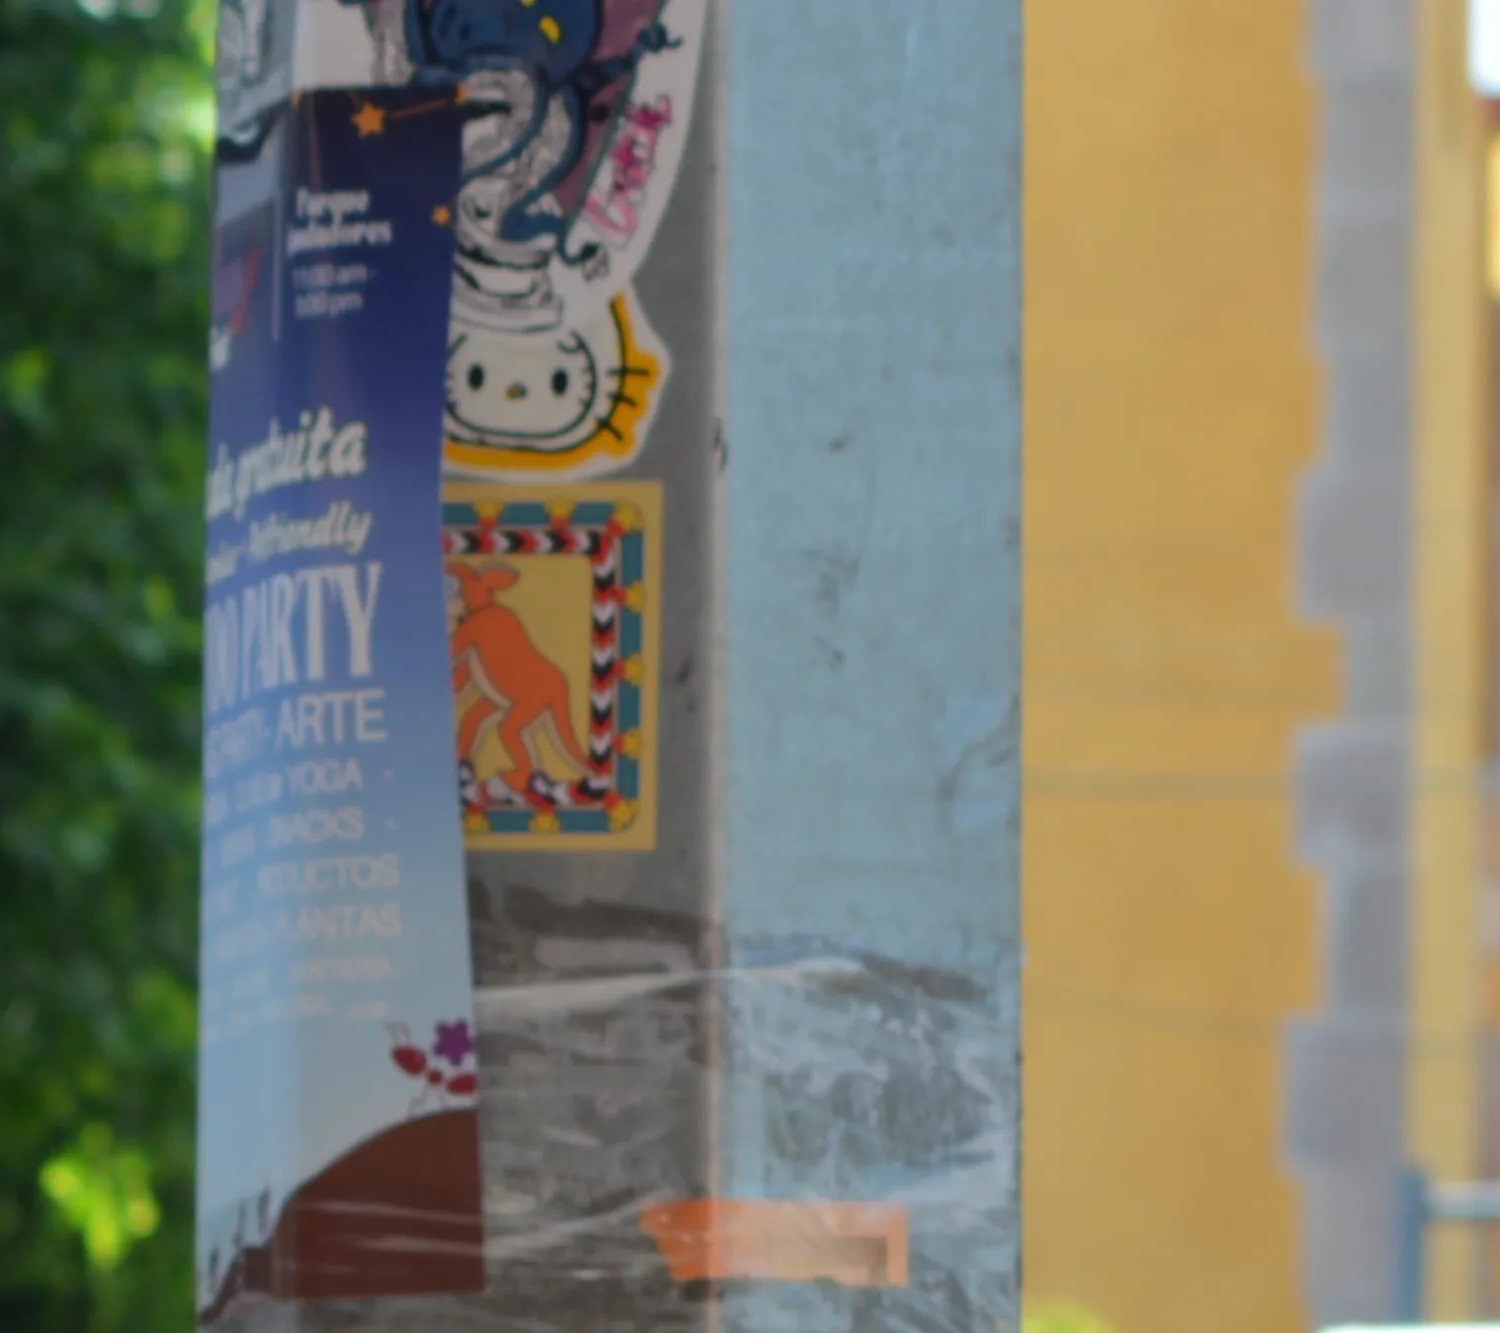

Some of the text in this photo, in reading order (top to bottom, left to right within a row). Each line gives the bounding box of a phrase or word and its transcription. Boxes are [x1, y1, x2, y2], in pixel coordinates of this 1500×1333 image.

[241, 560, 384, 700] PARTY
[275, 687, 389, 750] ARTE
[287, 757, 364, 796] YOGA
